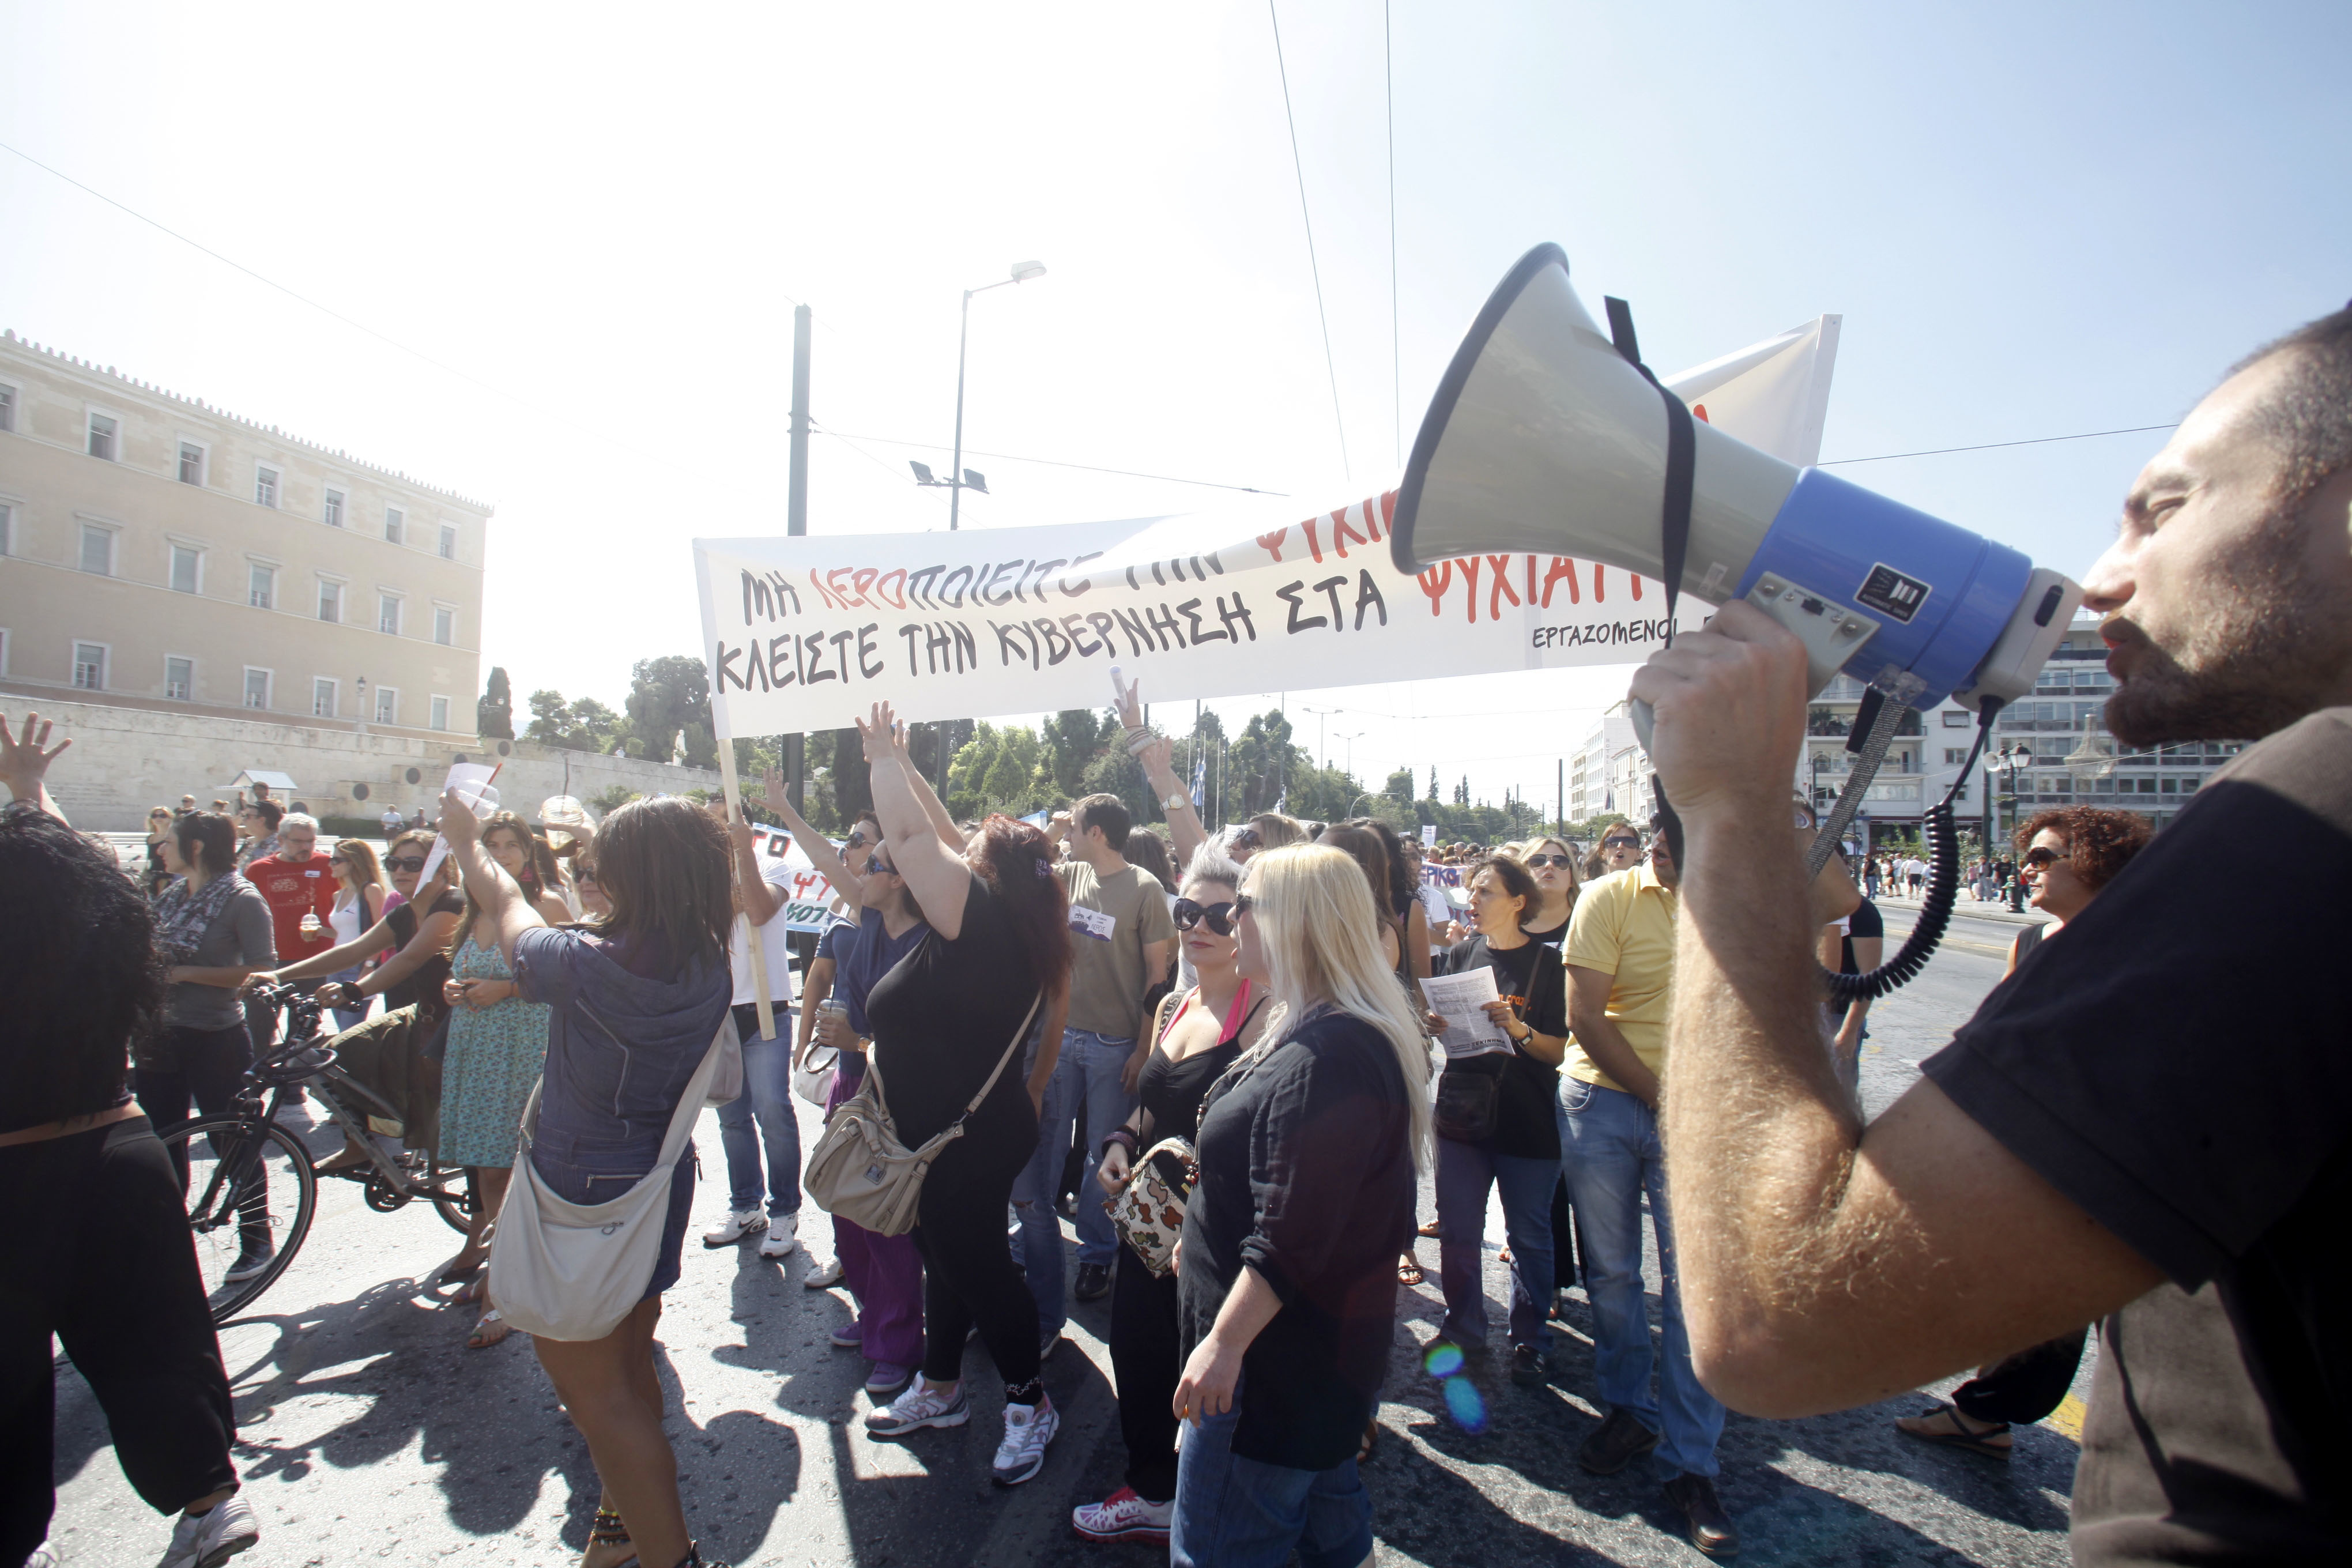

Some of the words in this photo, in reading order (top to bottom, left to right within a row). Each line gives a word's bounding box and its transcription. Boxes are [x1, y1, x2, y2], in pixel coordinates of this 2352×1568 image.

[741, 568, 801, 626] ΜΗ
[809, 551, 1104, 611] ΛΕΡΟΠΟΙΕΙΤΕ
[717, 623, 884, 693] ΚΛΕΙΣΤΕ
[899, 620, 977, 677] ΤΗΝ
[987, 591, 1256, 671] ΚΥΒΕΡΝΗΣΗ
[1275, 568, 1388, 635] ΣΤΑ
[1533, 618, 1677, 648] ΕΡΓΑΖΟΜΕΝΟΙ
